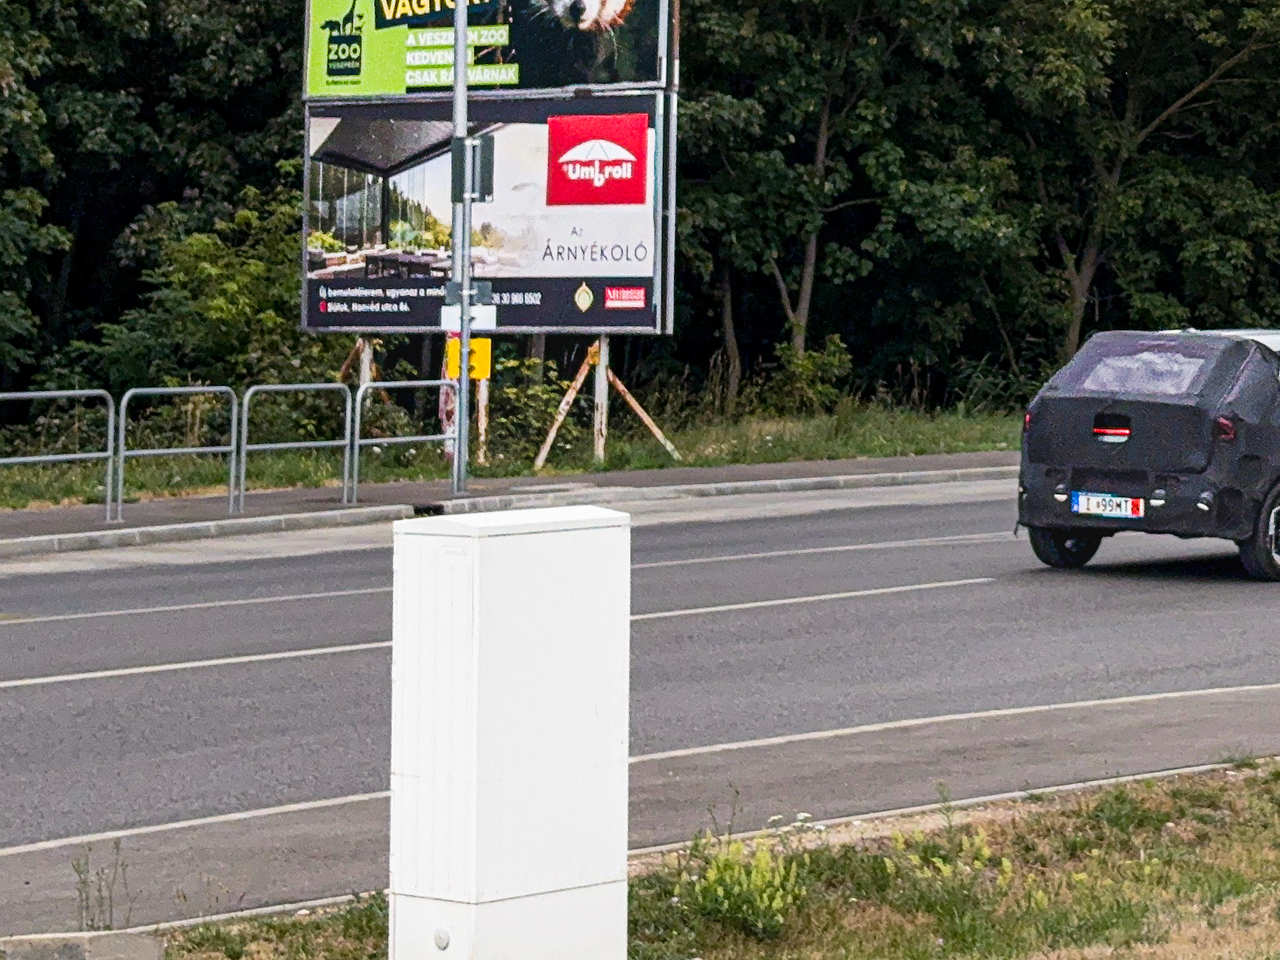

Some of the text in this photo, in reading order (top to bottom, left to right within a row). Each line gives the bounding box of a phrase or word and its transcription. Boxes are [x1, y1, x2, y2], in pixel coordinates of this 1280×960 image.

[481, 29, 506, 41] ZOO
[328, 43, 361, 60] ZOO
[405, 69, 439, 86] CSAK
[542, 238, 647, 262] ÁRNYÉKOLÓ
